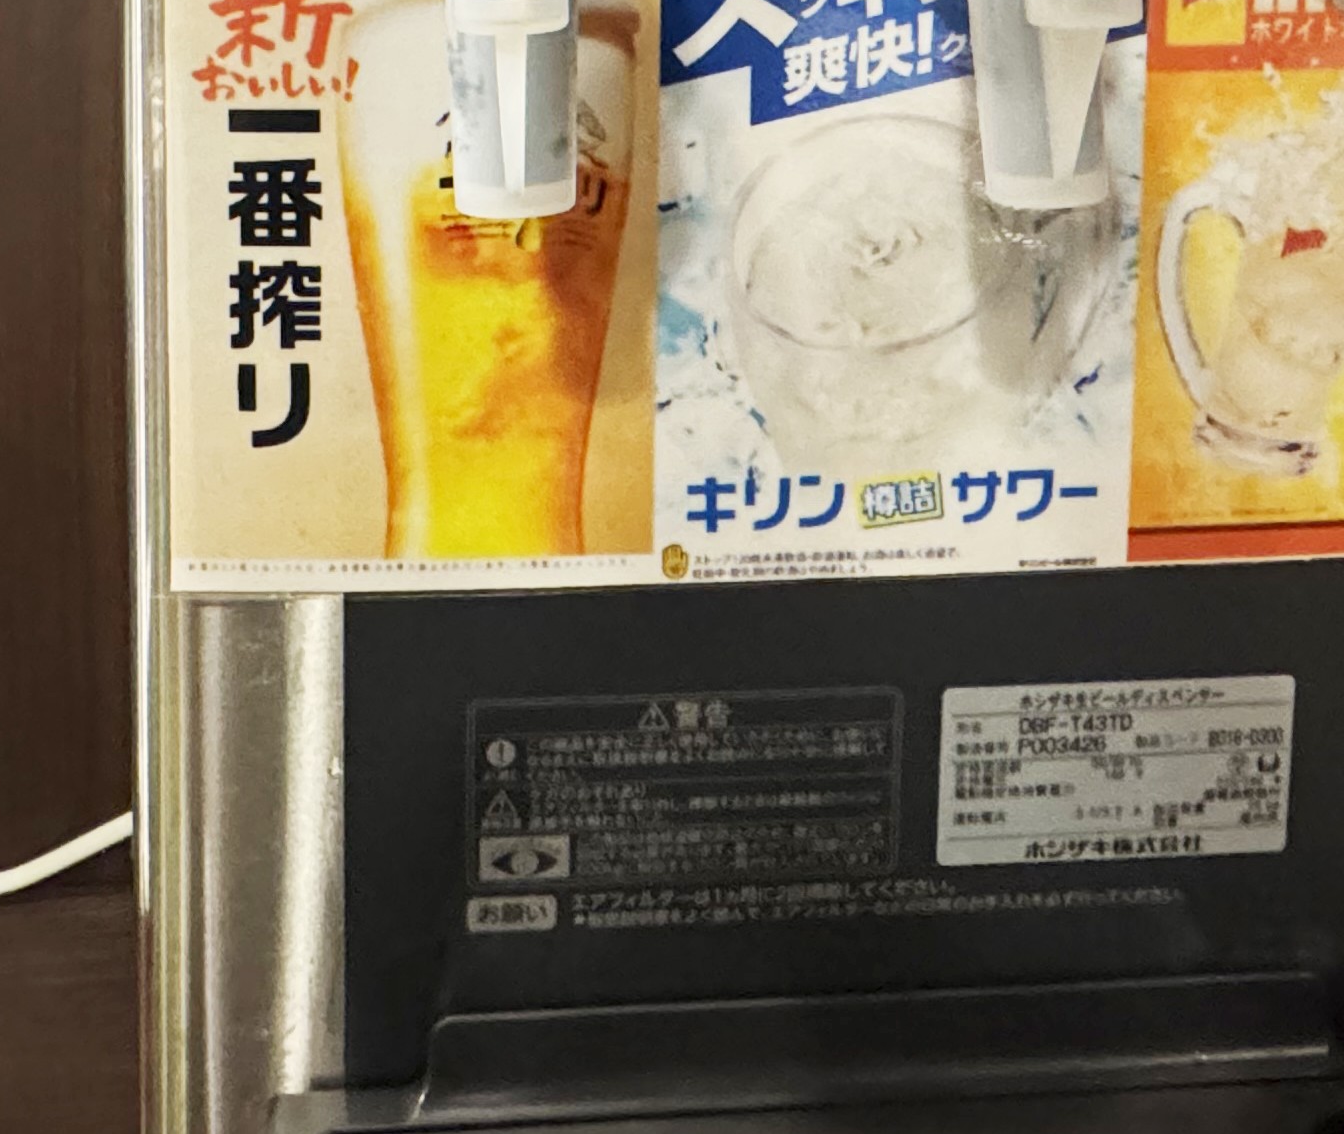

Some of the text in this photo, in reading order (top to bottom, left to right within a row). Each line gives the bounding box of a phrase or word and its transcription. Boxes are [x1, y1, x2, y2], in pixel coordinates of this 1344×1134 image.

[191, 59, 359, 103] おいしい!
[227, 108, 324, 449] 一番搾り
[686, 475, 846, 534] キリン
[951, 468, 1099, 525] サワー
[1017, 735, 1107, 755] P003426
